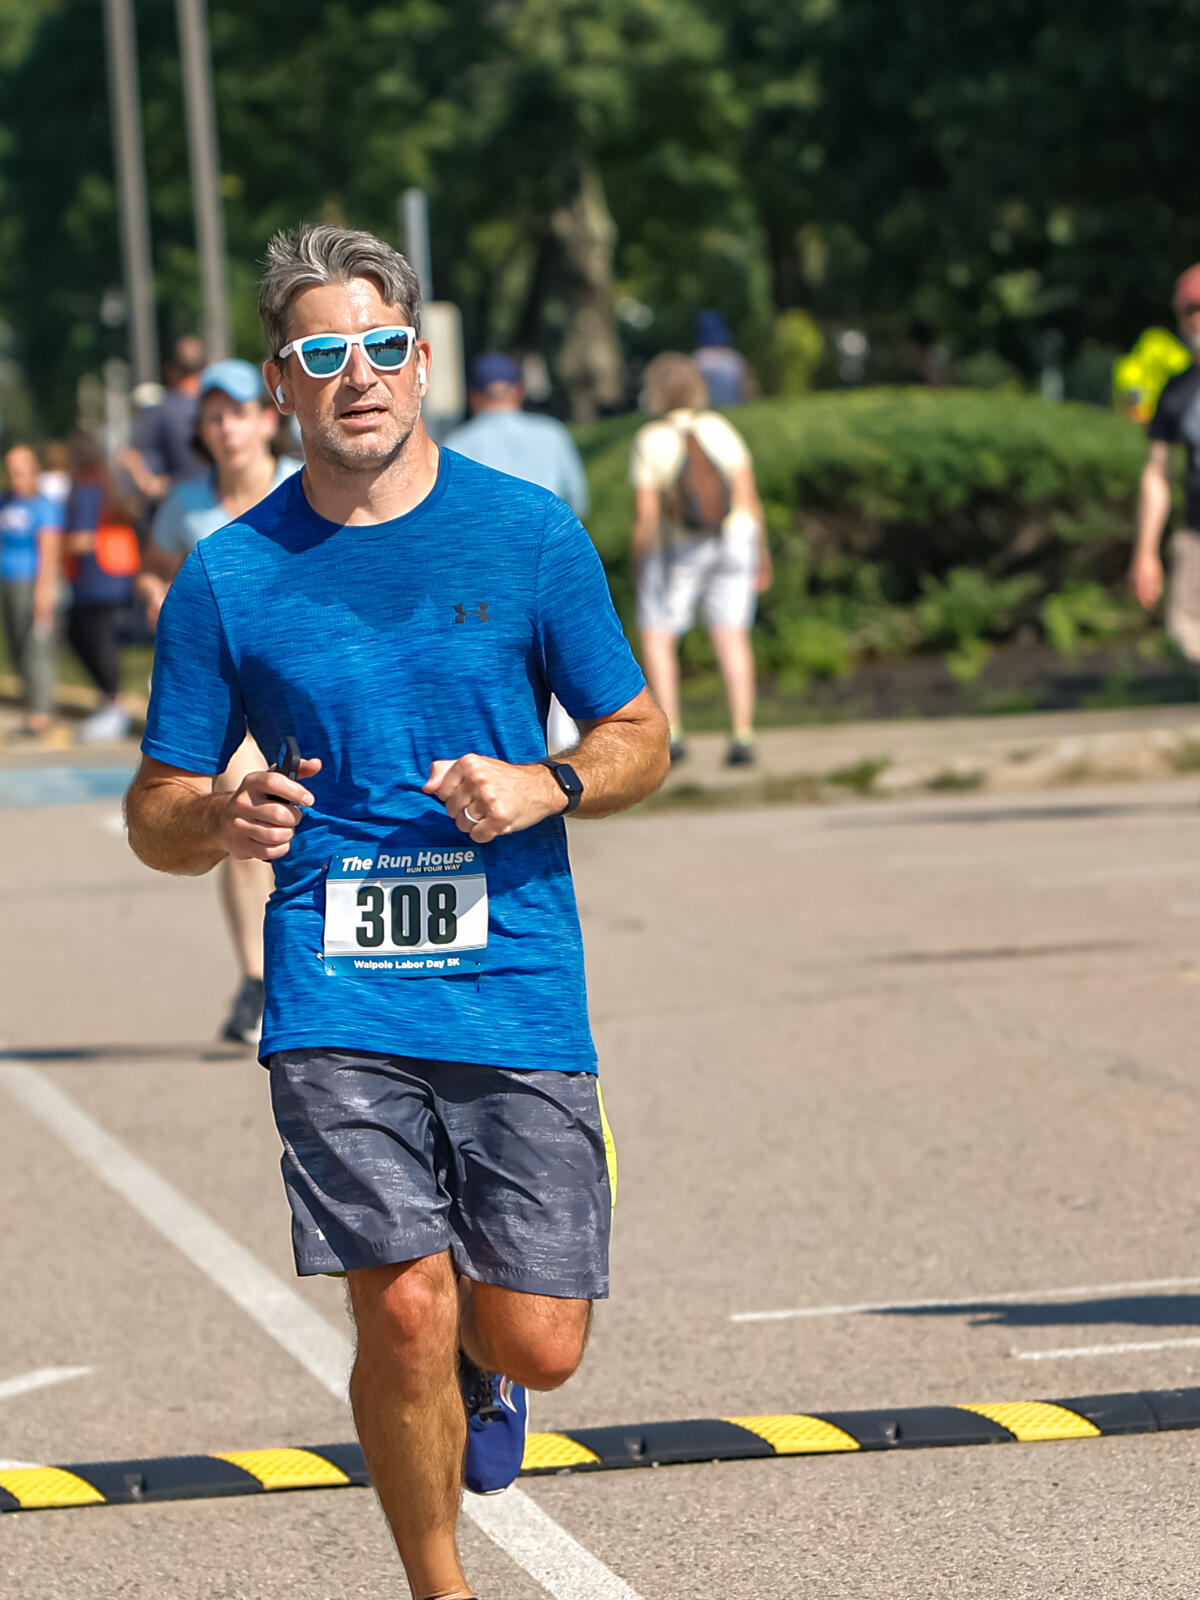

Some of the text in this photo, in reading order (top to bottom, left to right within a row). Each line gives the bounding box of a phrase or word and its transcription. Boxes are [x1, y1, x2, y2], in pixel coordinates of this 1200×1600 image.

[341, 850, 475, 872] The Run House
[406, 864, 461, 874] RUN YOUR WAY
[356, 883, 458, 948] 308
[354, 958, 461, 970] Walpole Labor Day 5K
